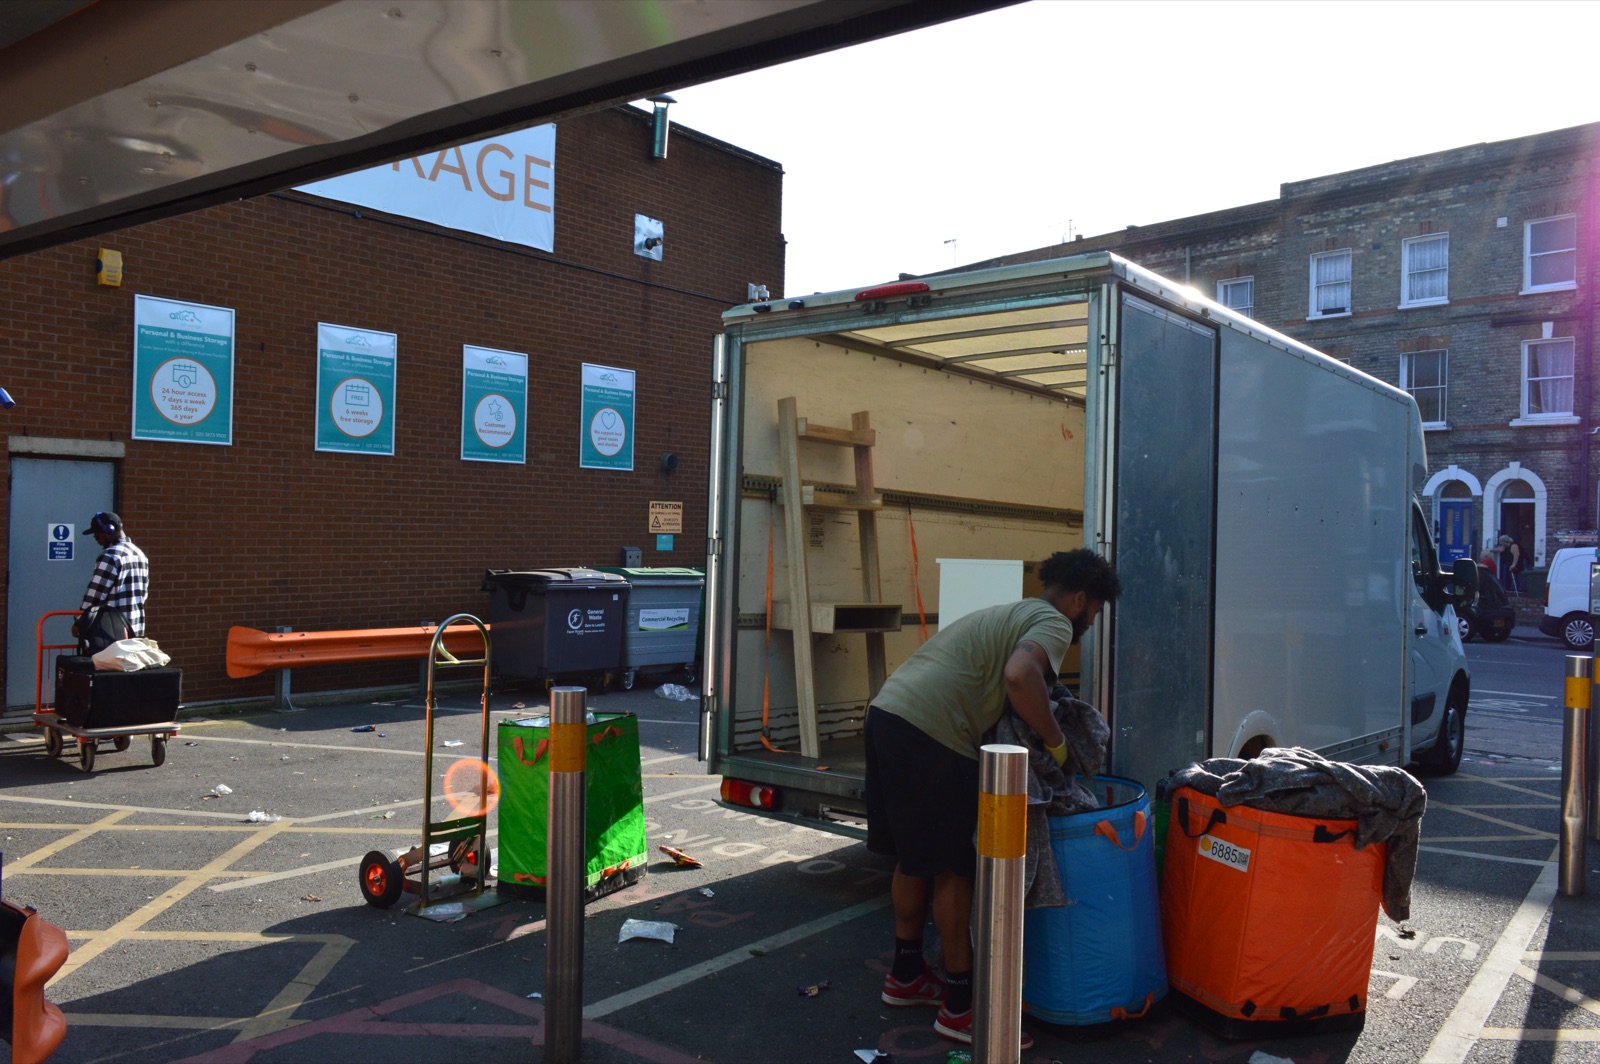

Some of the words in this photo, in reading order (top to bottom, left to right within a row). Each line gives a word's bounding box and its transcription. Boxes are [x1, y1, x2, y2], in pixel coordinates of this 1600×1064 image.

[140, 328, 168, 337] Personal
[177, 333, 202, 342] Business
[204, 337, 228, 346] Storage
[322, 352, 345, 360] Personal
[373, 359, 392, 367] Storage
[184, 405, 198, 413] days
[1212, 841, 1238, 863] 6885
